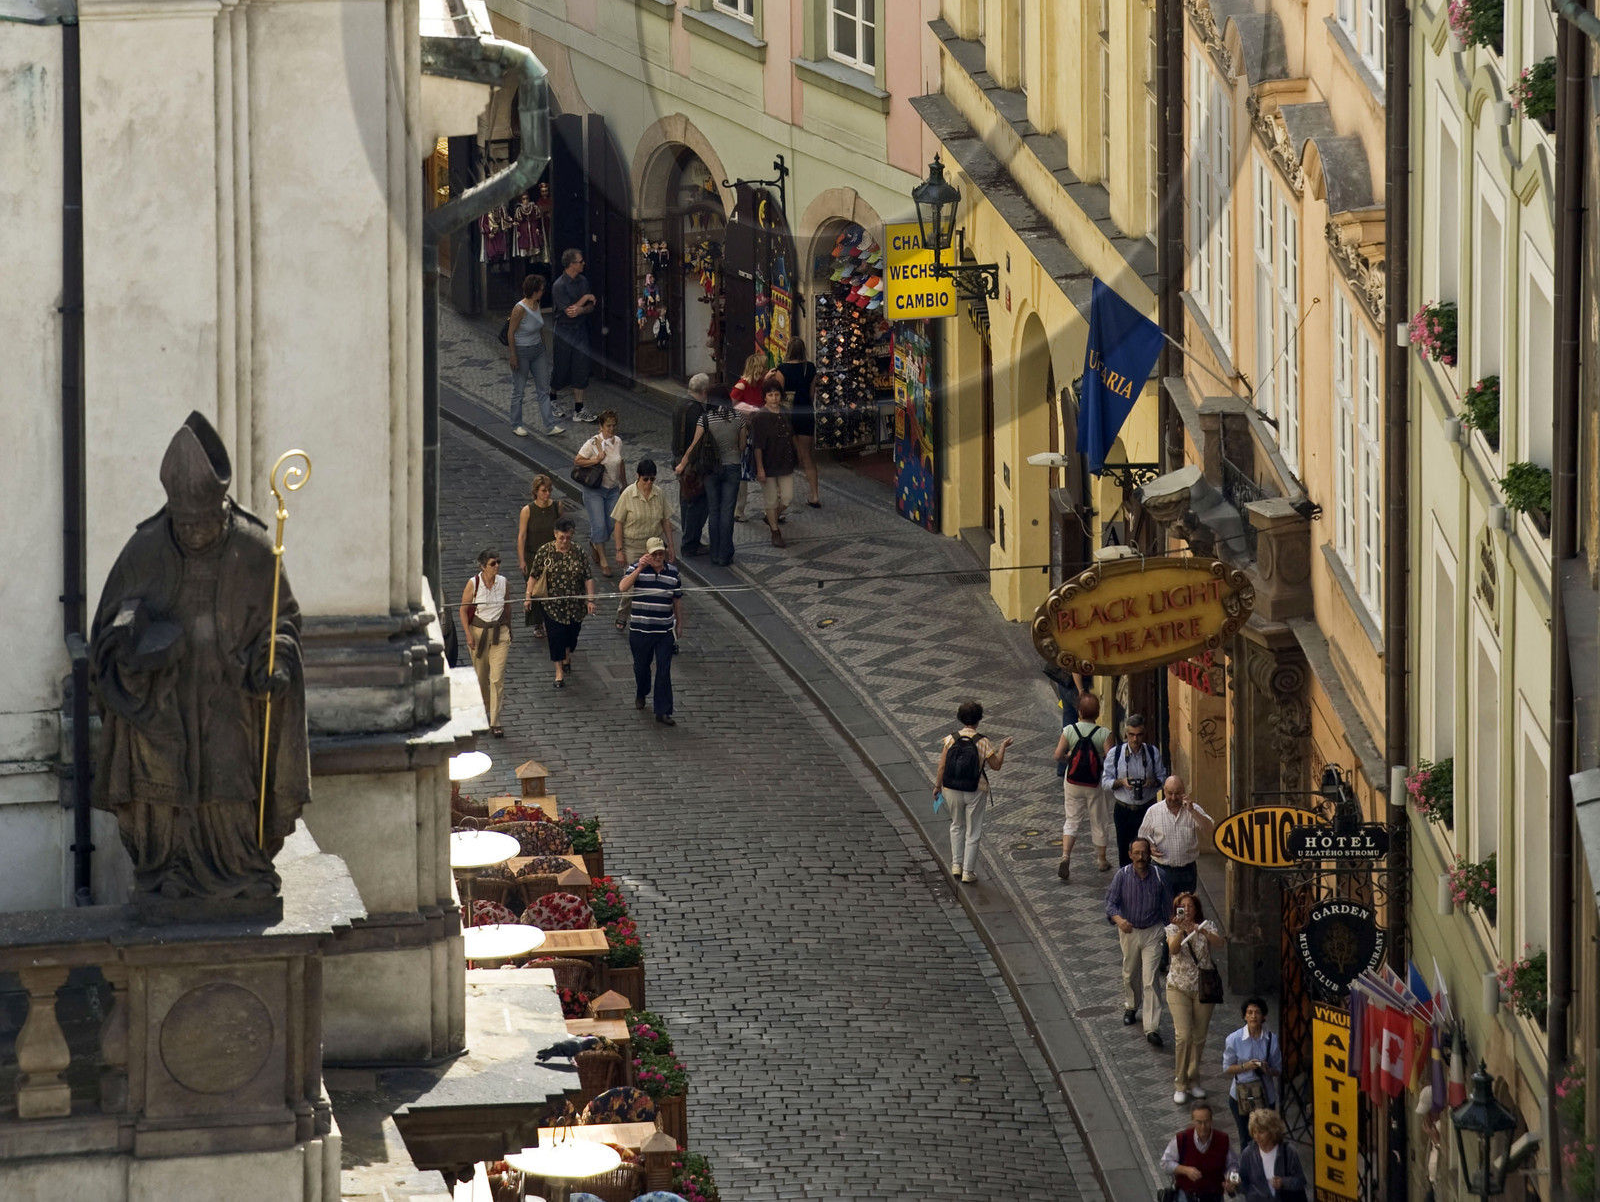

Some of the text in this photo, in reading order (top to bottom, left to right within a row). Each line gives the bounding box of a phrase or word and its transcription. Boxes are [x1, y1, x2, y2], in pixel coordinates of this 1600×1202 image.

[896, 292, 949, 309] CAMBIO
[1056, 578, 1225, 633] BLACK LIGHT
[1086, 616, 1204, 660] THEATRE
[1305, 836, 1375, 848] HOTEL
[1305, 849, 1343, 857] ZLATÉHO
[1312, 904, 1369, 921] GARDEN
[1299, 933, 1339, 991] MUSIC CLUB
[1324, 1033, 1348, 1185] ANTIQUE
